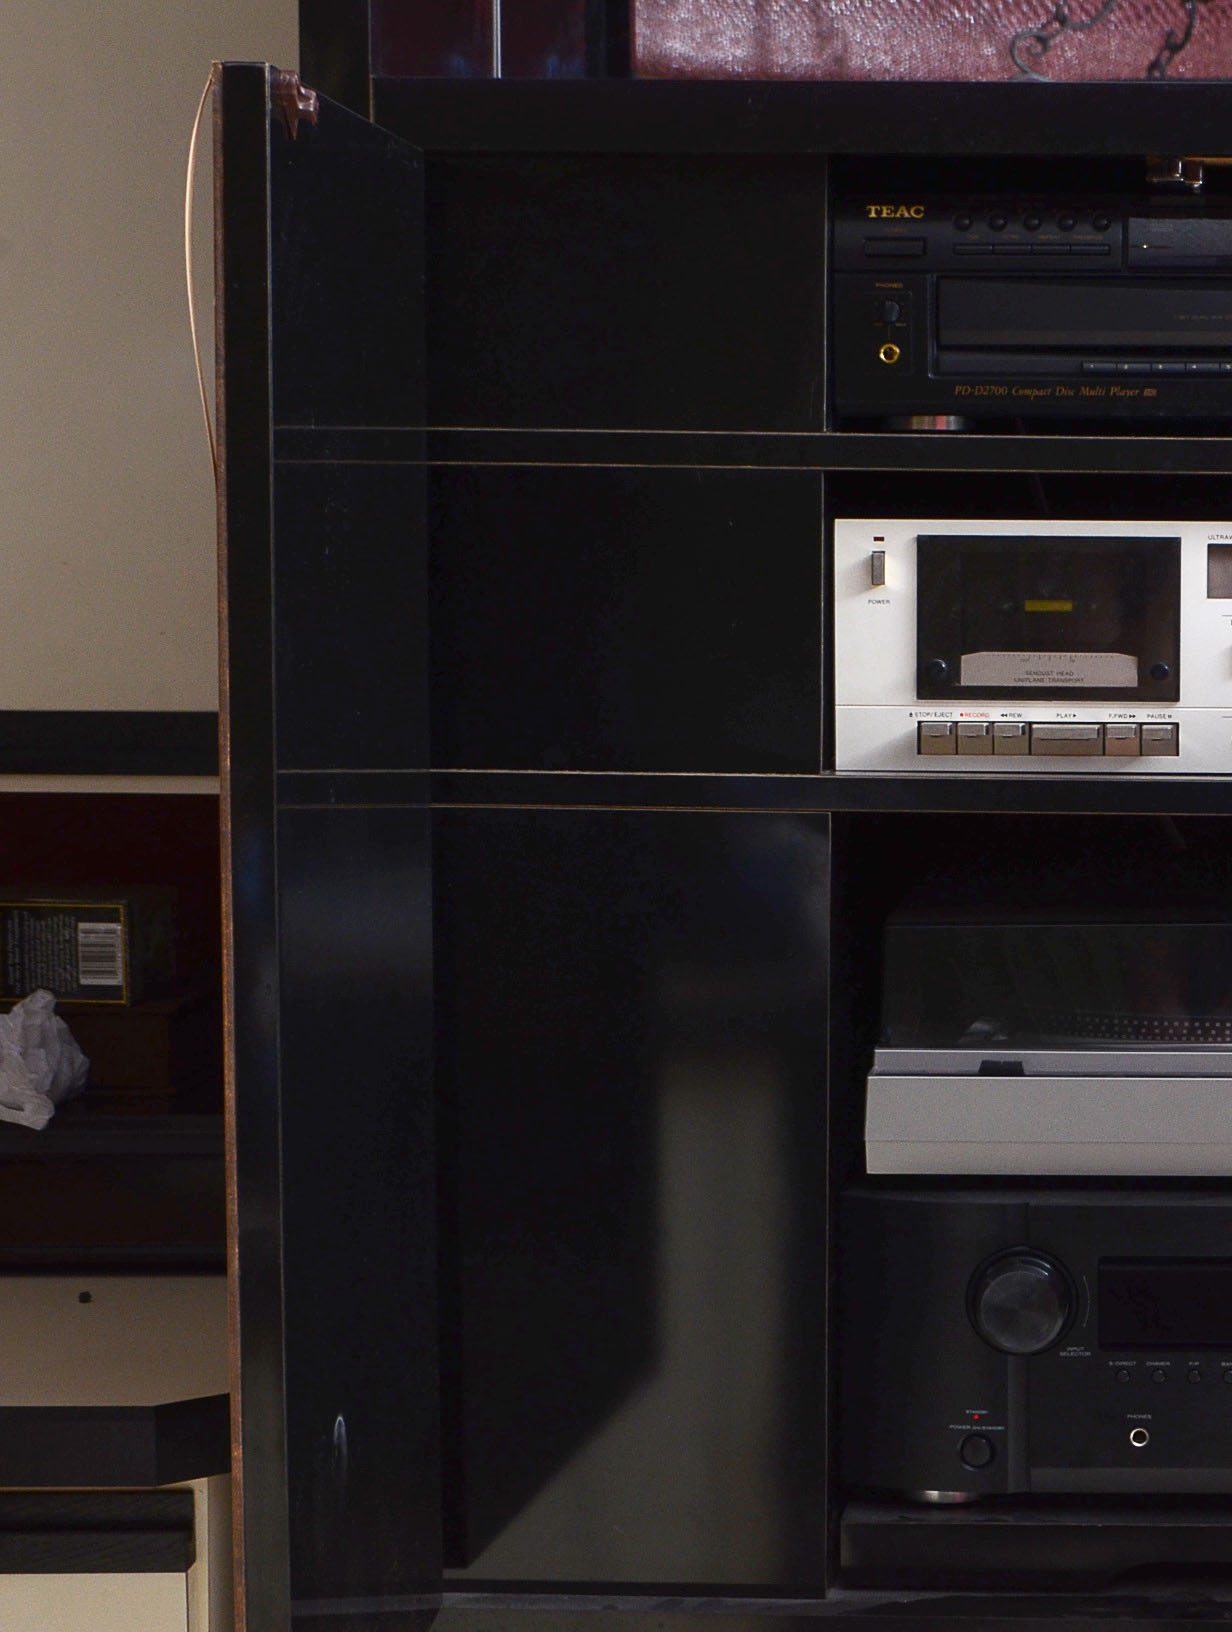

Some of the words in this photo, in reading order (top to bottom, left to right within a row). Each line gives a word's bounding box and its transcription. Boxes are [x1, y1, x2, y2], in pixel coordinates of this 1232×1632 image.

[866, 204, 926, 219] TEAC
[1011, 385, 1052, 399] Compact
[1055, 385, 1075, 396] Disc
[1079, 385, 1105, 396] Multi
[1109, 385, 1140, 399] Player
[867, 598, 892, 607] POWER
[965, 711, 990, 719] RECORD
[1056, 711, 1073, 719] PLAY
[1147, 712, 1167, 720] PAUSE
